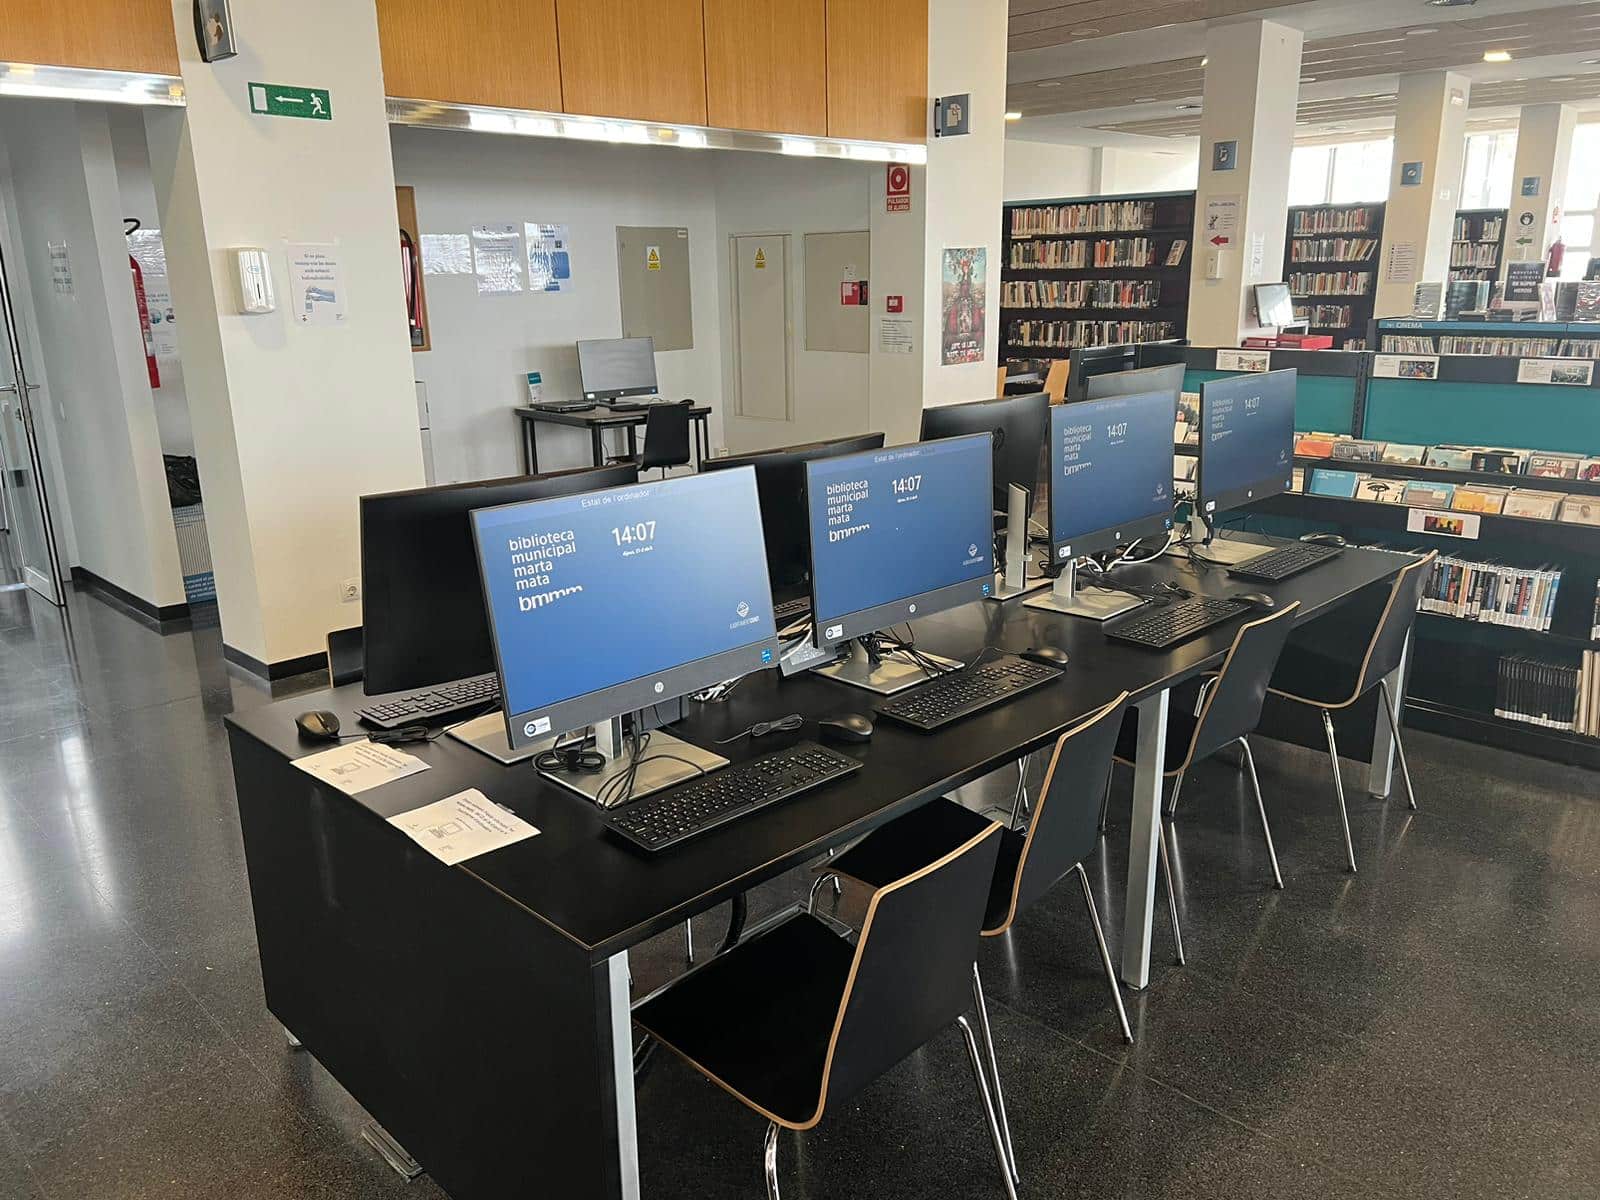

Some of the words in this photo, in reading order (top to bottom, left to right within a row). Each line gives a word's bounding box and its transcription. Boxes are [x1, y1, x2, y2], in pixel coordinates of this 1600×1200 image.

[1064, 424, 1092, 436] biblioteca
[1107, 422, 1127, 438] 14:07
[1064, 444, 1080, 453] marta
[1064, 452, 1078, 462] mata
[827, 480, 868, 495] biblioteca
[892, 475, 922, 494] 14:07
[581, 498, 601, 508] Estat
[828, 489, 868, 505] municipal
[828, 503, 853, 515] marta
[829, 514, 850, 526] mata
[509, 530, 575, 551] biblioteca
[612, 521, 656, 546] 14:07
[512, 541, 576, 564] municipal
[514, 560, 553, 577] marta
[516, 575, 550, 590] mata
